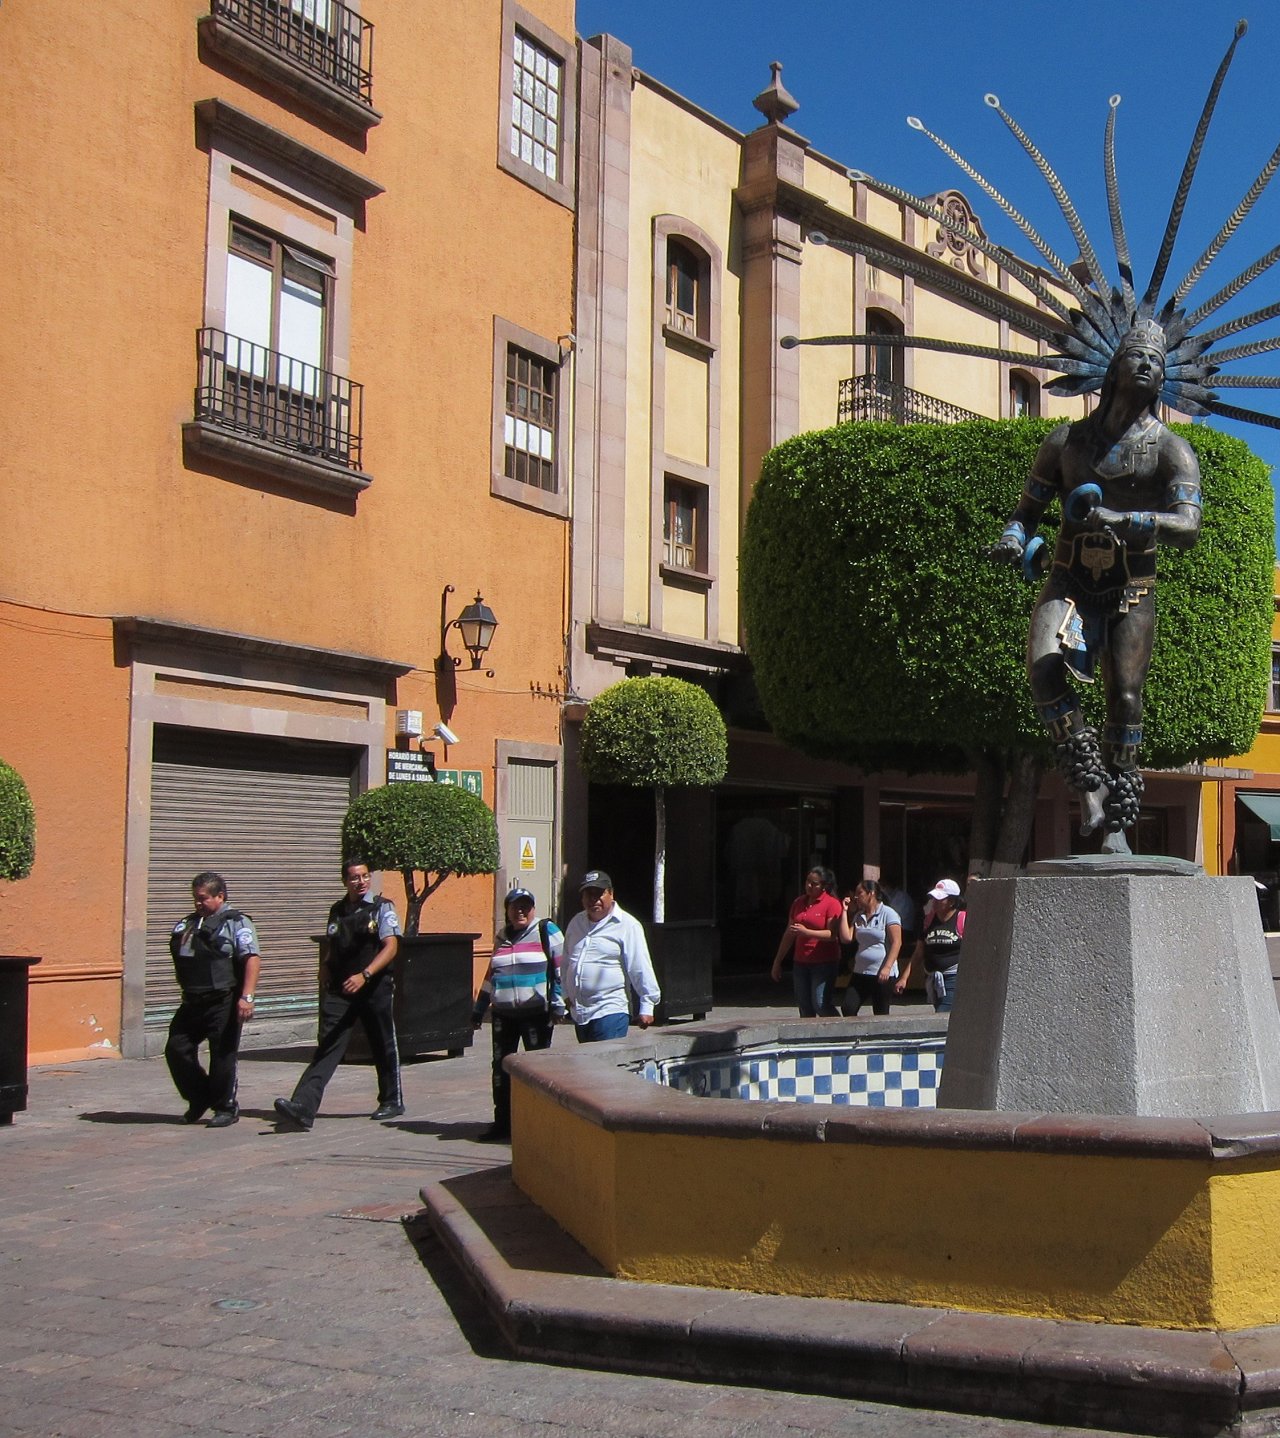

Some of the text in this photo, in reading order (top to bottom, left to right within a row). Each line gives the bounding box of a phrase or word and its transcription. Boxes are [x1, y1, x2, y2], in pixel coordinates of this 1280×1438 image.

[388, 751, 409, 761] HORARIO
[410, 753, 417, 761] DE
[394, 762, 401, 770] DE
[388, 772, 396, 780] DE
[395, 772, 411, 780] LUNES
